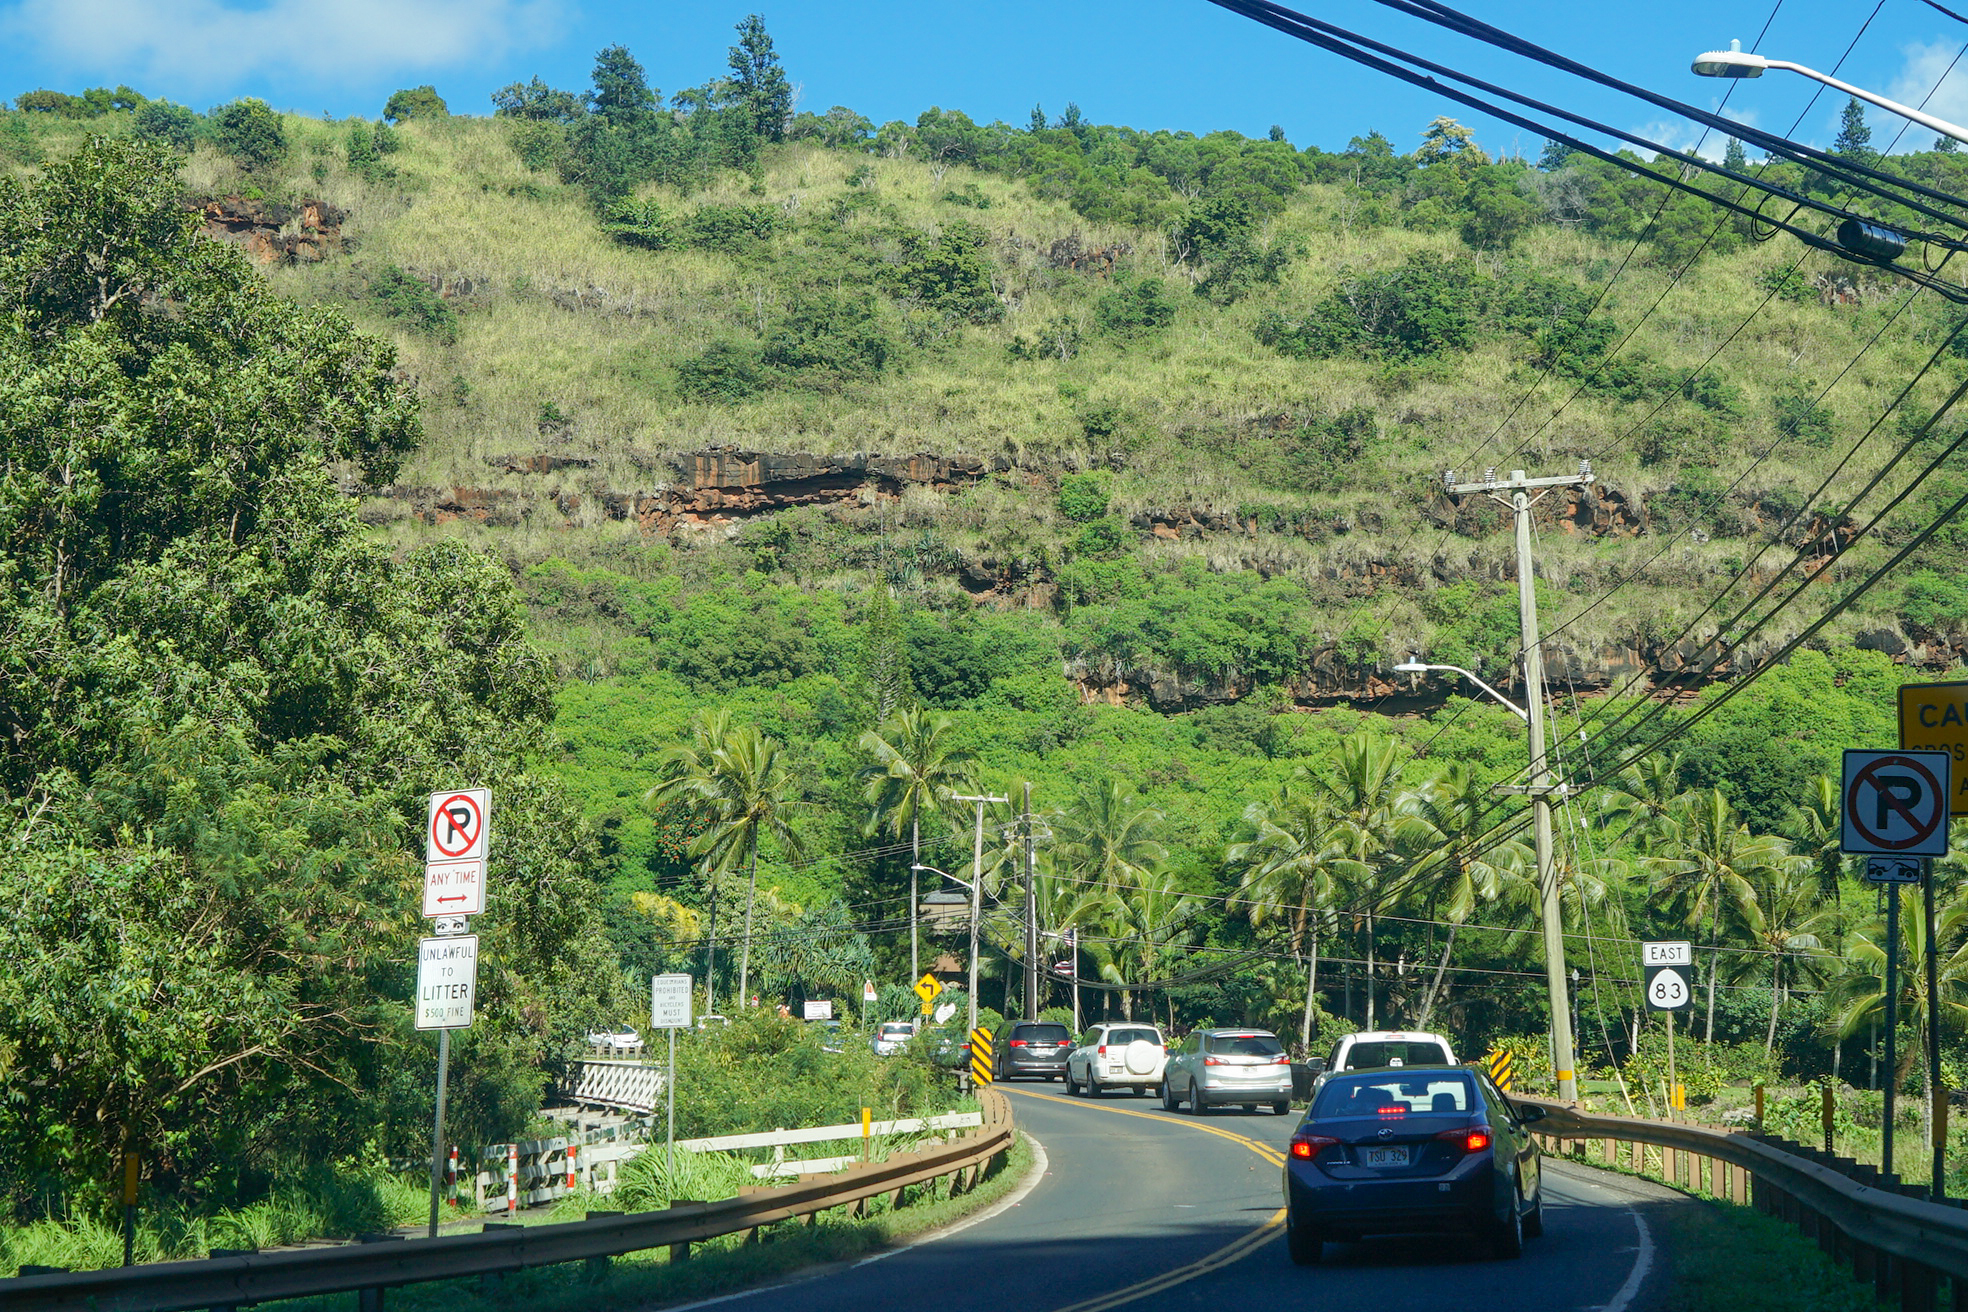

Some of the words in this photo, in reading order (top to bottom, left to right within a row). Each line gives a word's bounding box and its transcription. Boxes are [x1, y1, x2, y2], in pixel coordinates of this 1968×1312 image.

[1919, 703, 1968, 728] CA
[430, 872, 450, 886] ANY
[454, 870, 477, 885] TIME
[423, 946, 473, 960] UNLAWFUL
[1651, 947, 1682, 960] EAST
[441, 967, 454, 977] TO
[423, 983, 469, 1001] LITTER
[656, 986, 688, 994] PROHIBITED
[1656, 983, 1681, 999] 83
[425, 1008, 444, 1018] $500
[447, 1007, 464, 1017] FINE
[1369, 1150, 1386, 1162] TSU
[1390, 1149, 1407, 1161] 329
